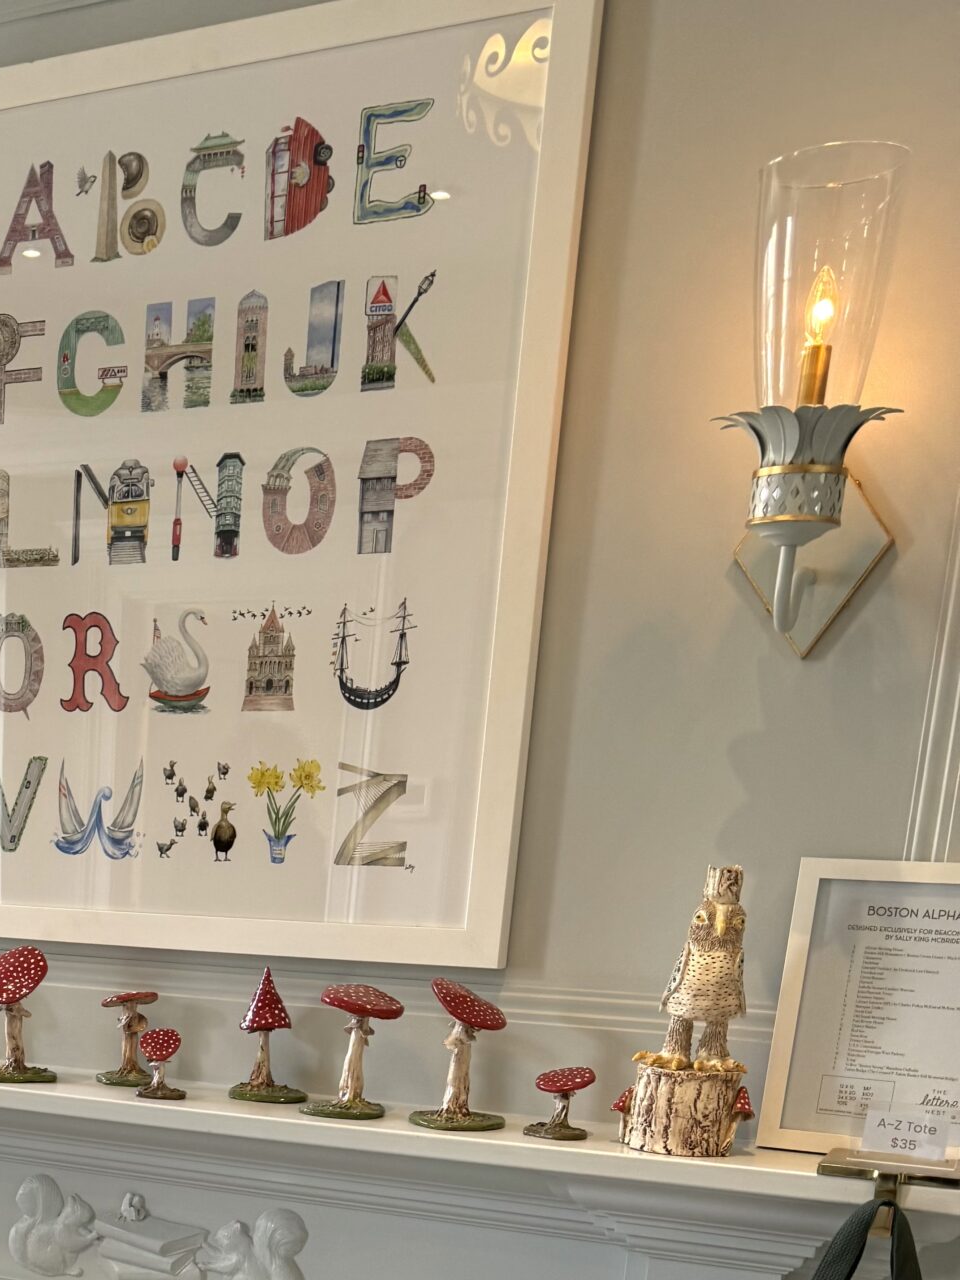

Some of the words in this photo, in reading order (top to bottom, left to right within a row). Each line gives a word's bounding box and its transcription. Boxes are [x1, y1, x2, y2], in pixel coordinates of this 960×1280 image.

[867, 906, 919, 919] BOSTON
[879, 926, 917, 934] EXCLUSIVELY
[877, 1118, 903, 1131] A-Z
[907, 1121, 937, 1135] Tote
[891, 1137, 917, 1151] $35
